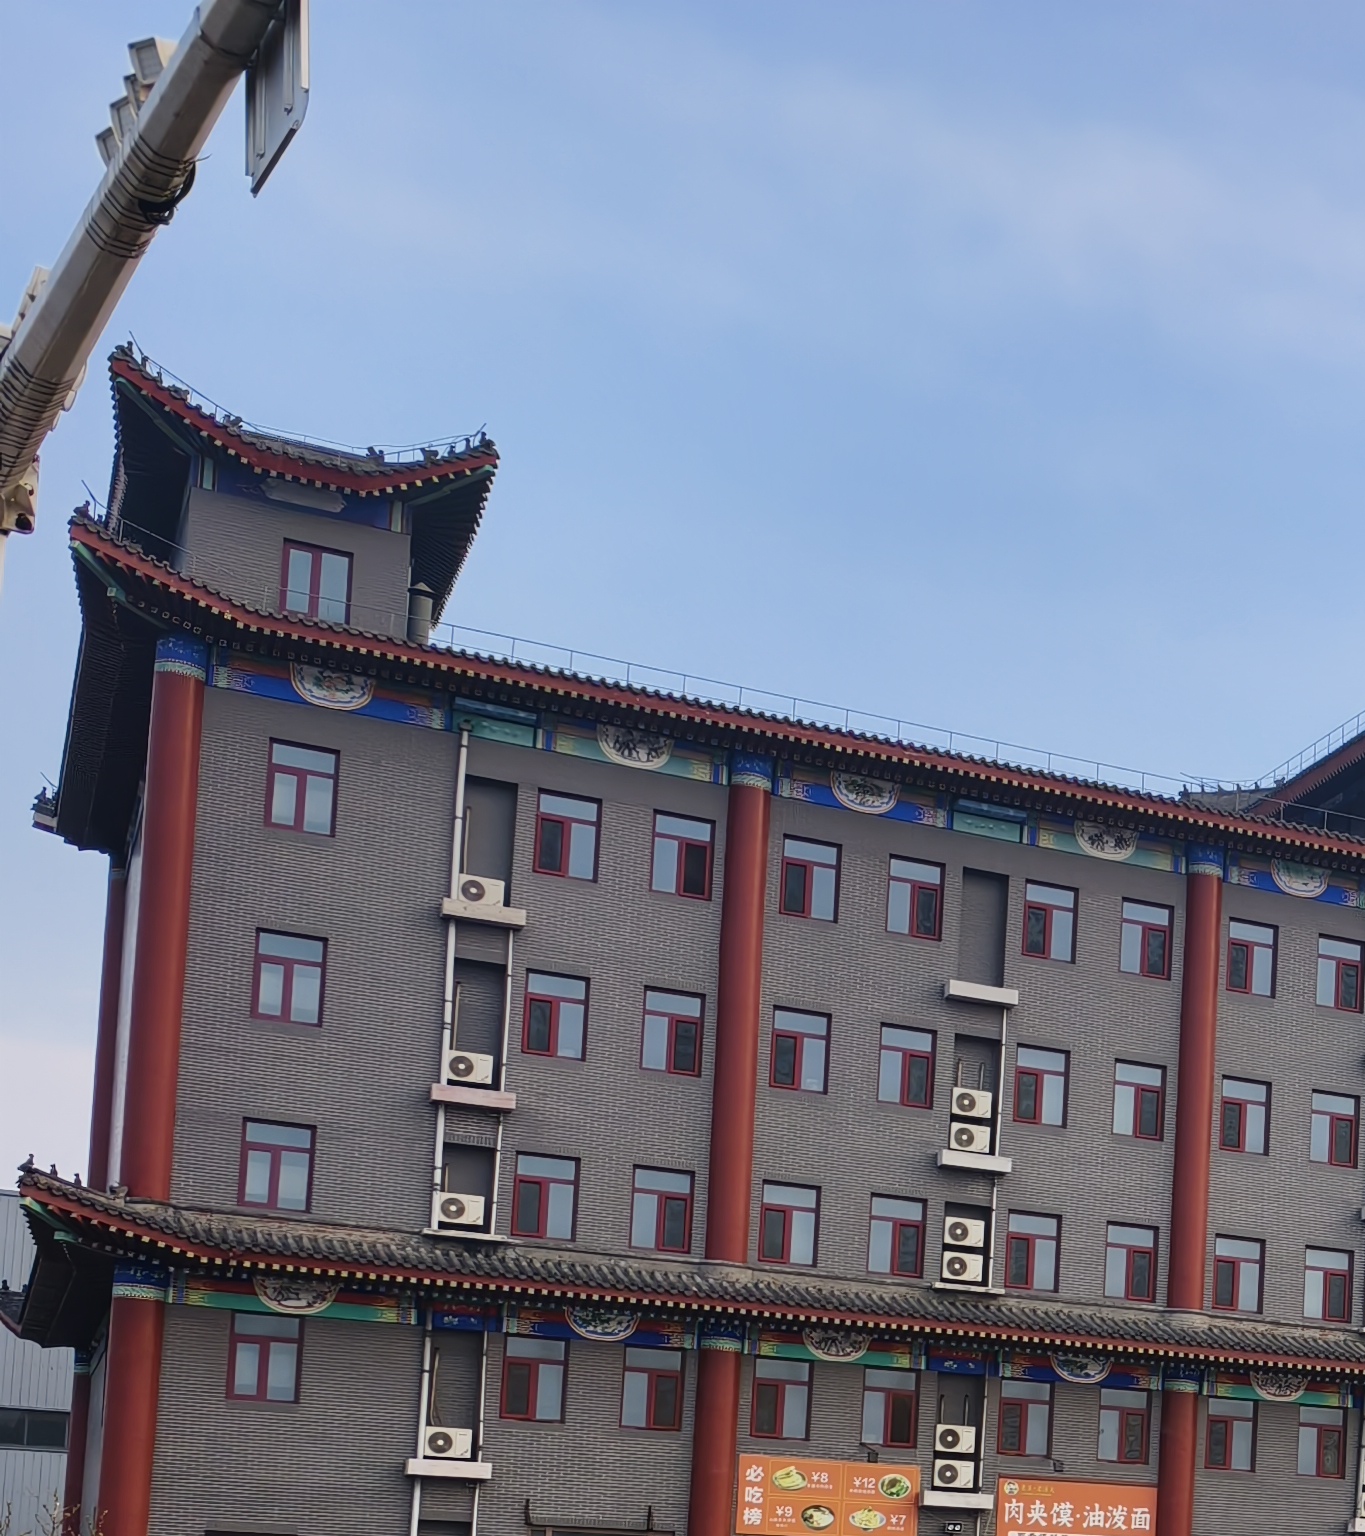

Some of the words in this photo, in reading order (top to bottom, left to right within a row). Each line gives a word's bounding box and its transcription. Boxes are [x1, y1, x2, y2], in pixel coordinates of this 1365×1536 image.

[811, 1471, 829, 1483] ¥8
[853, 1476, 876, 1489] ¥12
[743, 1464, 765, 1526] 必吃榜
[775, 1505, 793, 1517] ¥9
[890, 1514, 907, 1526] ¥7
